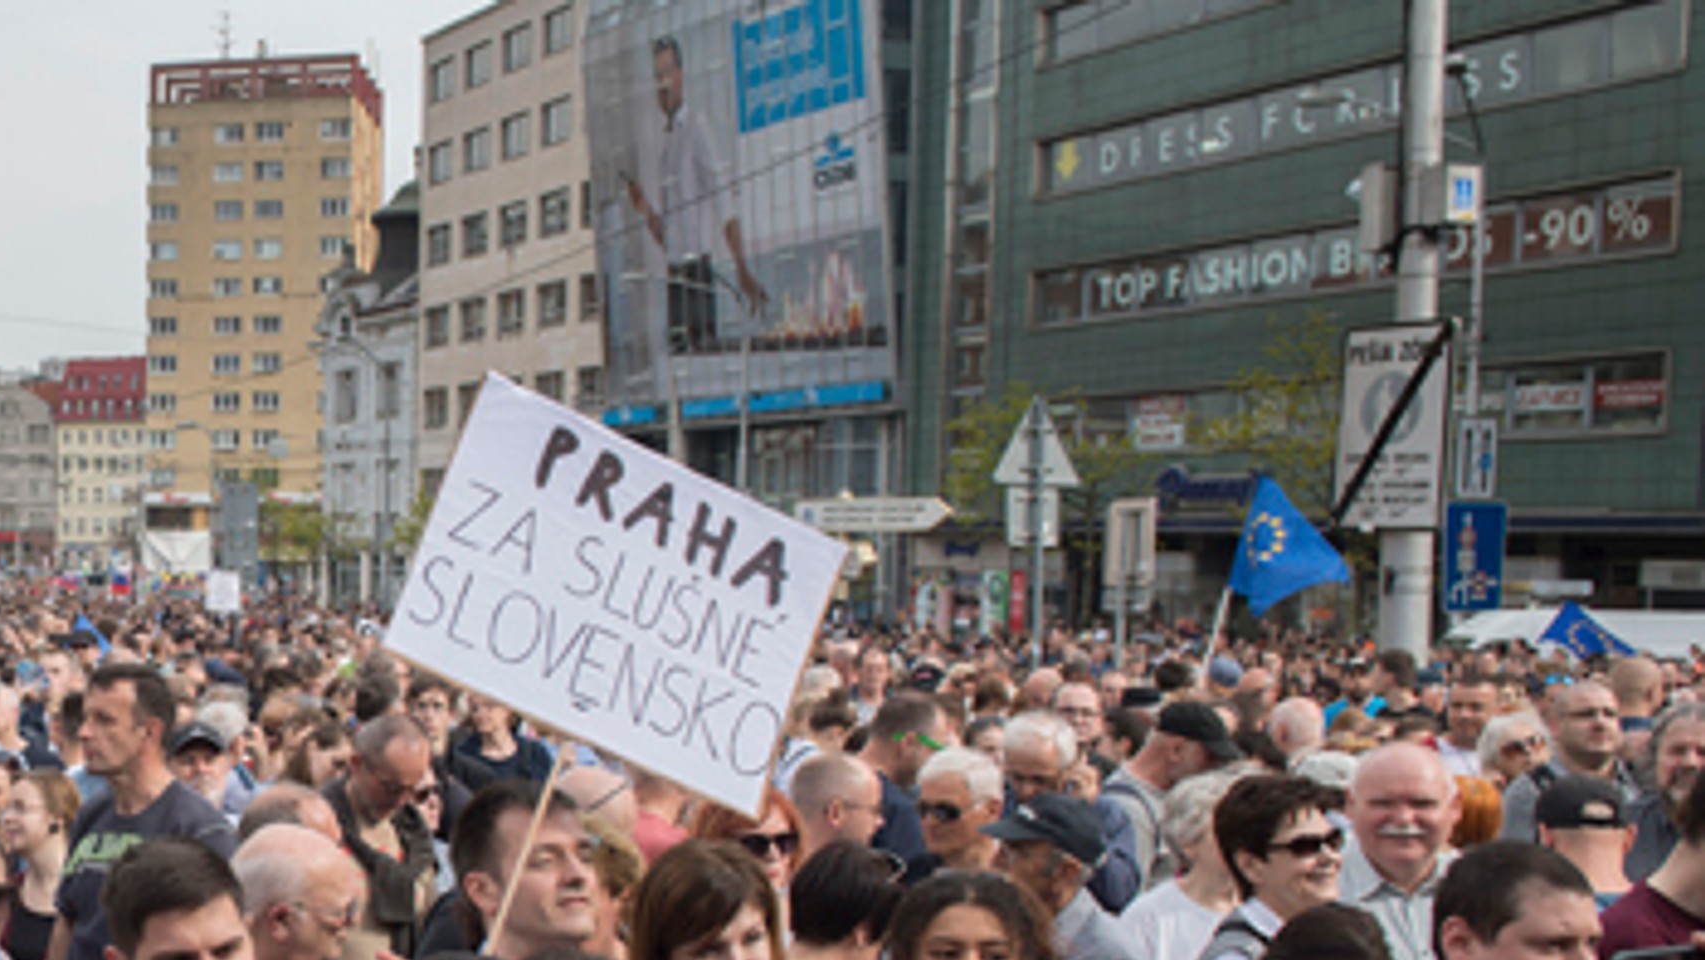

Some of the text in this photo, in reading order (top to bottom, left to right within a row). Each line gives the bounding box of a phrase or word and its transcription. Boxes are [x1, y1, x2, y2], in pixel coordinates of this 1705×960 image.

[1096, 271, 1156, 308] TOP
[1164, 245, 1310, 298] FASHION
[1524, 205, 1594, 249] -90
[1607, 197, 1651, 241] %
[447, 480, 790, 689] ZA SLUŠNÉ
[535, 425, 789, 608] PRAHA
[408, 555, 781, 777] SLOVENSKO
